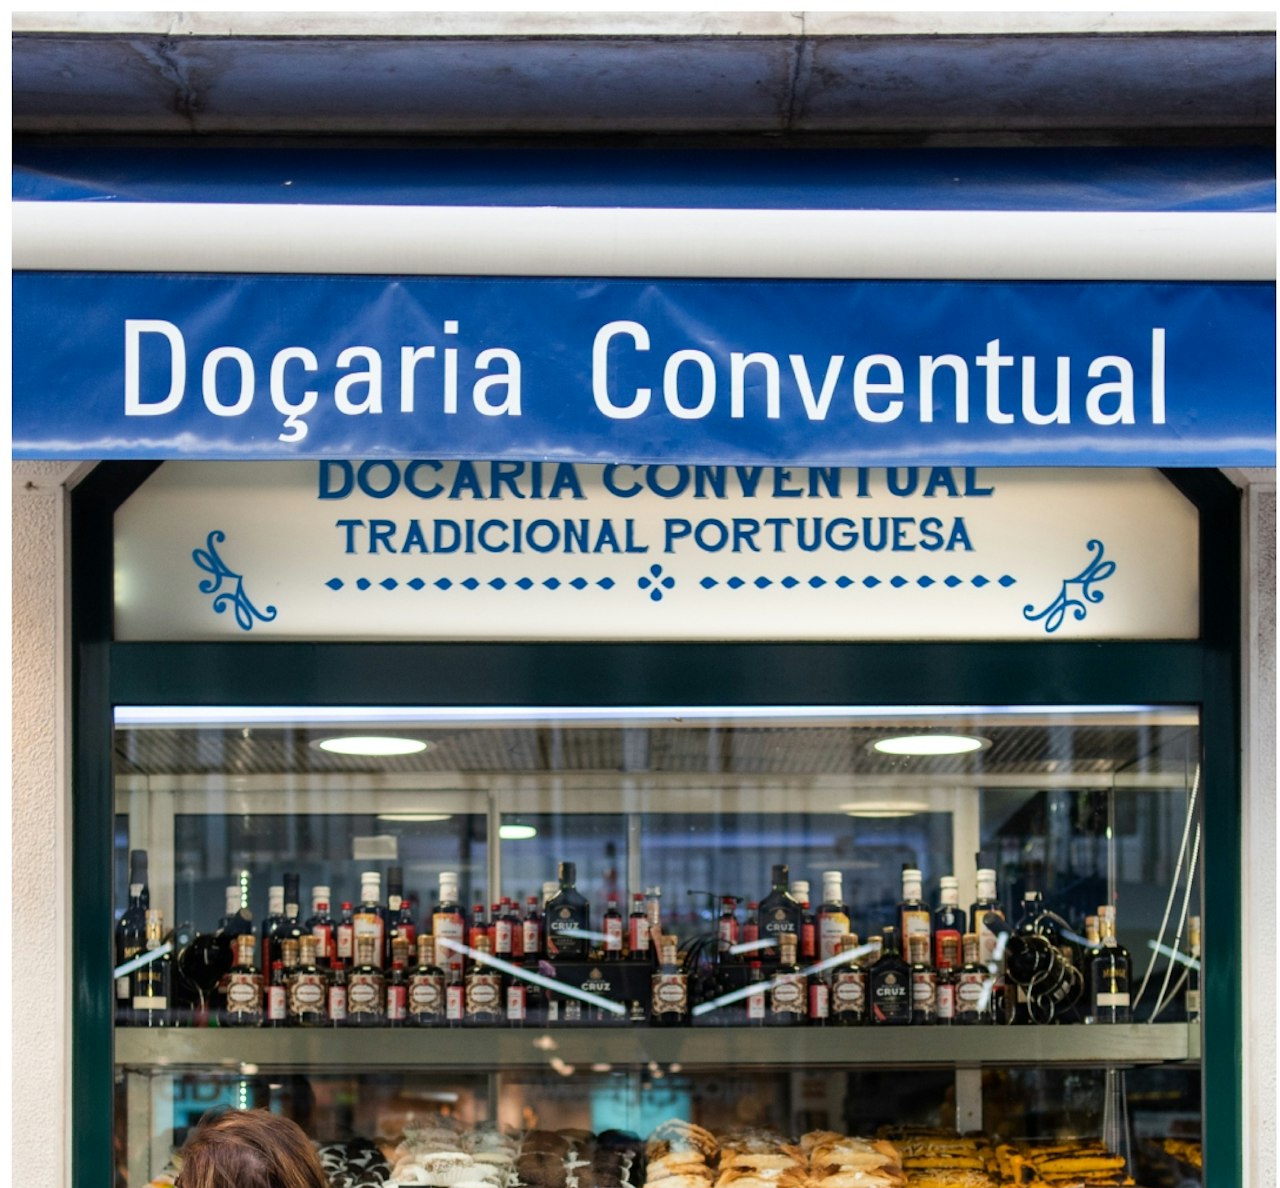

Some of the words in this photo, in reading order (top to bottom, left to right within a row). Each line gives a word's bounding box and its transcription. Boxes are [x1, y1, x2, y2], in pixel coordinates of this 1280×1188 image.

[124, 319, 522, 442] Doçaria
[592, 320, 1167, 427] Conventual
[336, 518, 649, 555] TRADICIONAL
[664, 516, 974, 554] PORTUGUESA
[581, 983, 611, 991] CRUZ
[876, 987, 906, 996] CRUZ
